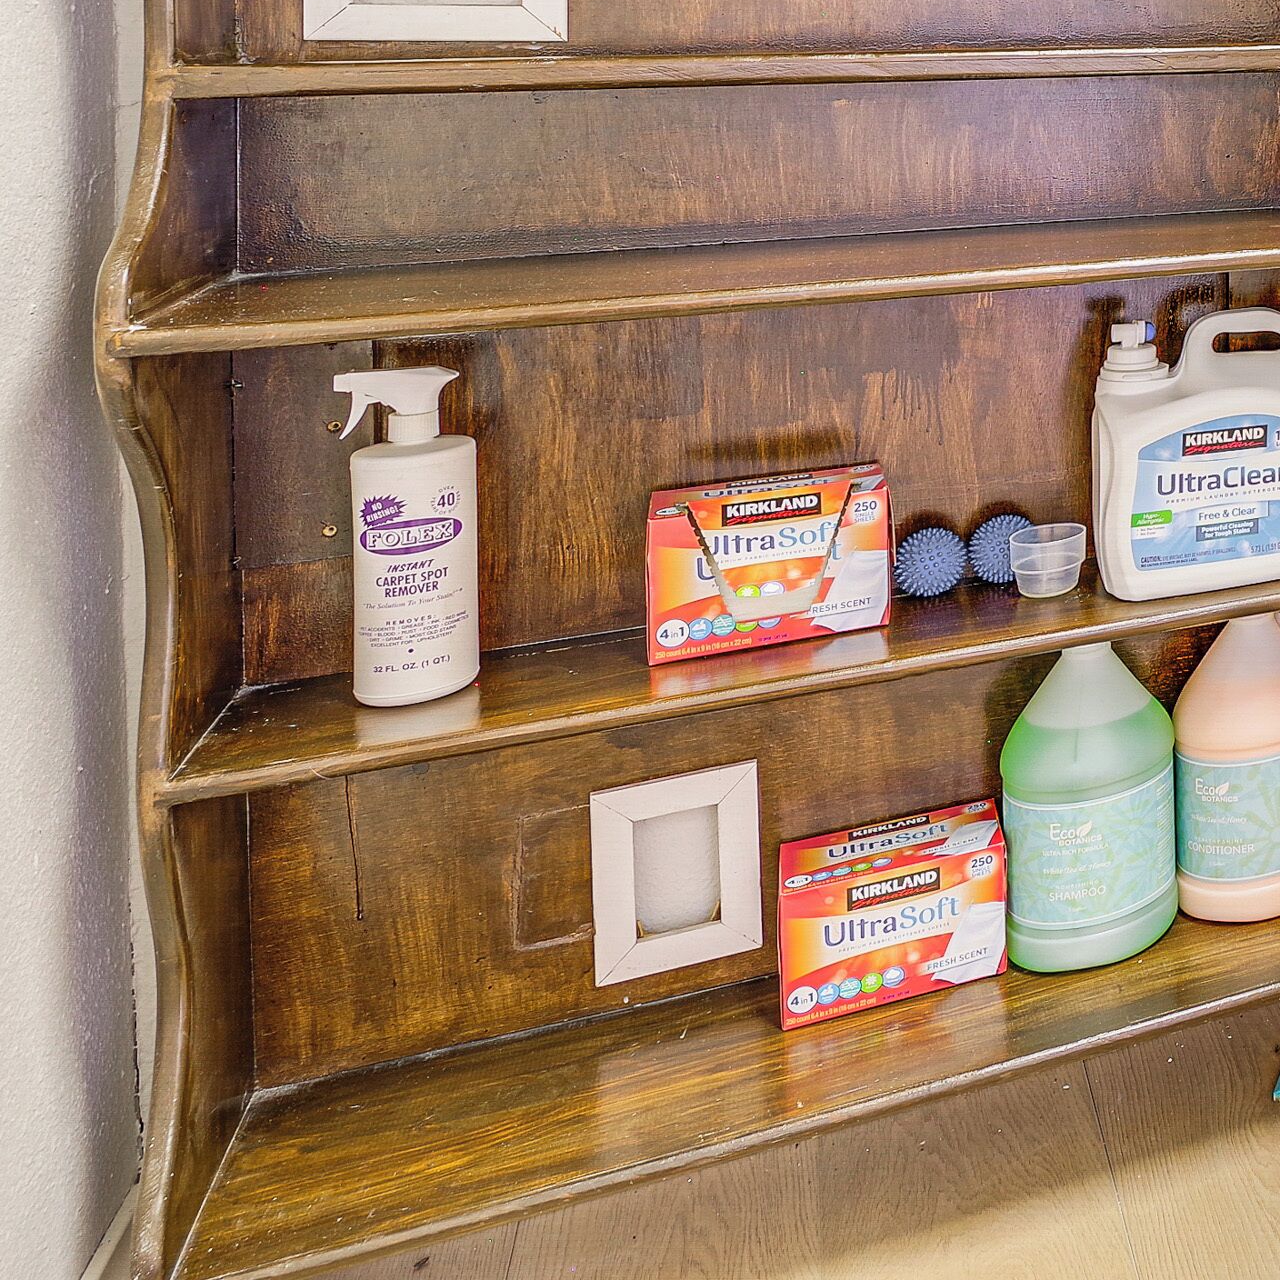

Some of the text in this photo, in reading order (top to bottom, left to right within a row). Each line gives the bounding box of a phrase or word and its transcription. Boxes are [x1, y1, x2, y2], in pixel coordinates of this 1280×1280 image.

[1185, 426, 1265, 447] KIRKLAND
[371, 502, 383, 511] NO
[437, 492, 455, 507] 40
[726, 494, 877, 519] KIRKLAND 250
[1166, 496, 1200, 504] PREMIUM
[1204, 491, 1238, 500] LAUNDRY
[366, 505, 399, 522] RINSING!
[1199, 506, 1257, 521] Free & Clear
[367, 522, 453, 548] FOLEX
[1201, 521, 1254, 533] Powerful Cleaning
[1214, 530, 1232, 539] Tough
[1233, 526, 1250, 535] Stains
[713, 521, 838, 555] ltraSof
[387, 559, 435, 573] INSTANT
[376, 566, 449, 587] CARPET SPOT
[384, 580, 439, 598] REMOVER
[809, 596, 872, 614] RESH SCENT
[660, 626, 685, 639] 4 in 1
[402, 662, 418, 670] OZ.
[421, 659, 429, 669] (1
[433, 654, 451, 665] QT.)
[1195, 777, 1215, 796] Eco
[1201, 795, 1239, 803] BOTANICS
[852, 816, 927, 837] KIRKLAND
[1049, 823, 1076, 841] Eco
[828, 824, 948, 858] UltraSoft
[1058, 834, 1103, 847] BOTANICS
[1187, 840, 1255, 855] CONDITIONER
[851, 855, 993, 902] KIRKLAND 250
[1049, 884, 1106, 902] SHAMPOO
[824, 896, 960, 947] UltraSoft
[927, 947, 988, 971] FRESH SCENT
[790, 992, 814, 1006] 4 in 1
